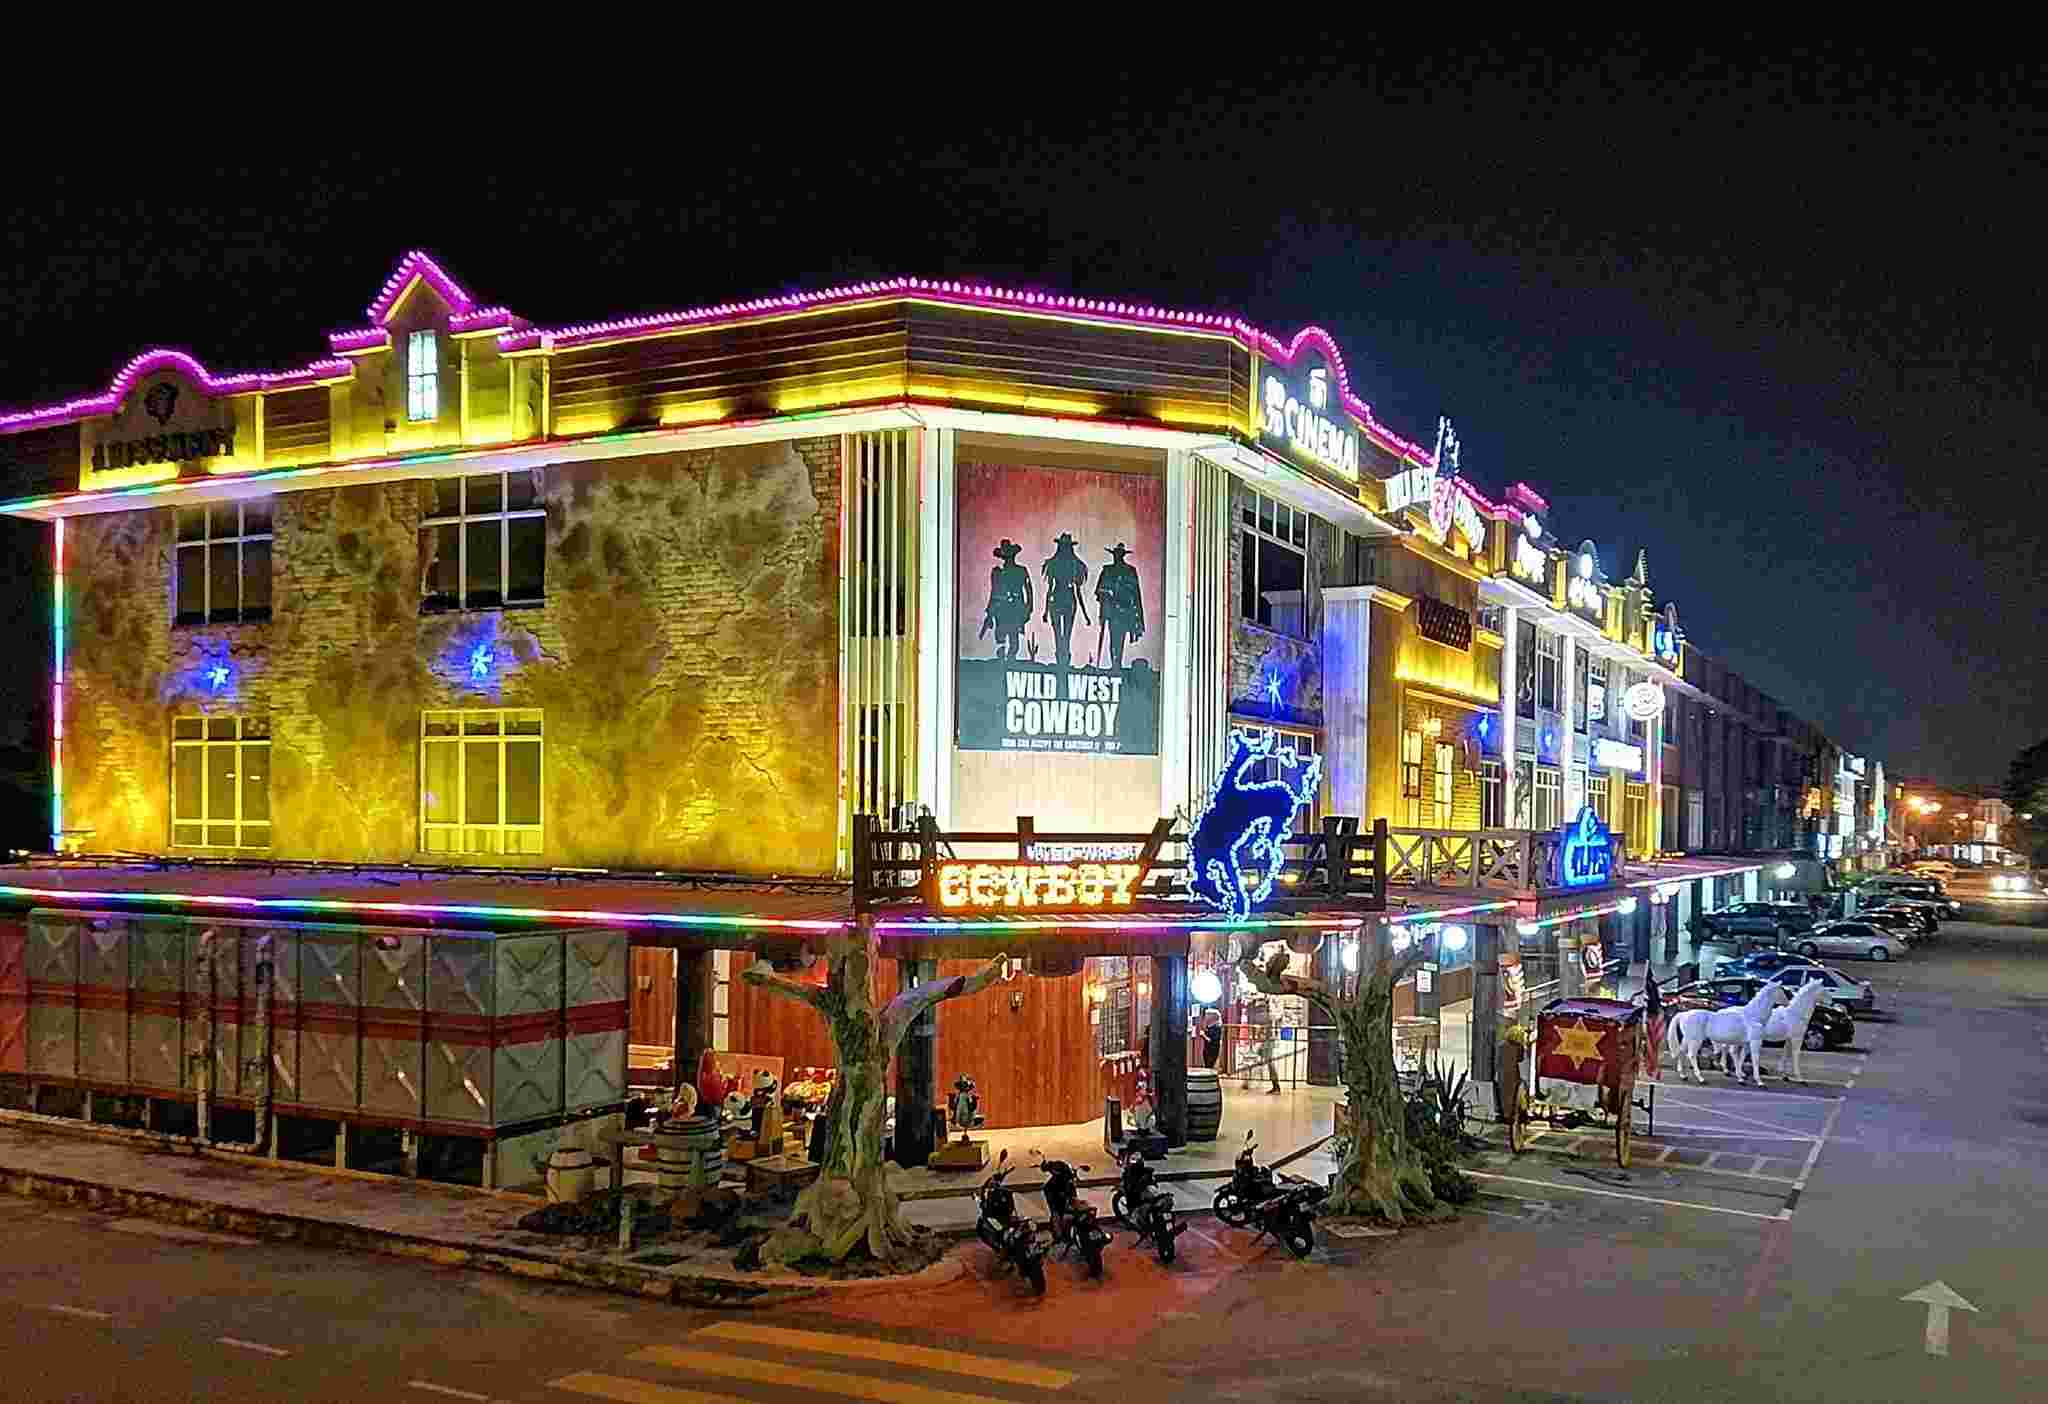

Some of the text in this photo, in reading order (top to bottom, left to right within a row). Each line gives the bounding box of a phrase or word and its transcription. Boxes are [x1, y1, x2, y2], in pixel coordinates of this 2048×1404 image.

[1284, 397, 1360, 482] CINEMA
[1006, 671, 1122, 703] WILD WEST
[1006, 698, 1119, 738] COWBOY
[939, 863, 1142, 907] COWBOY
